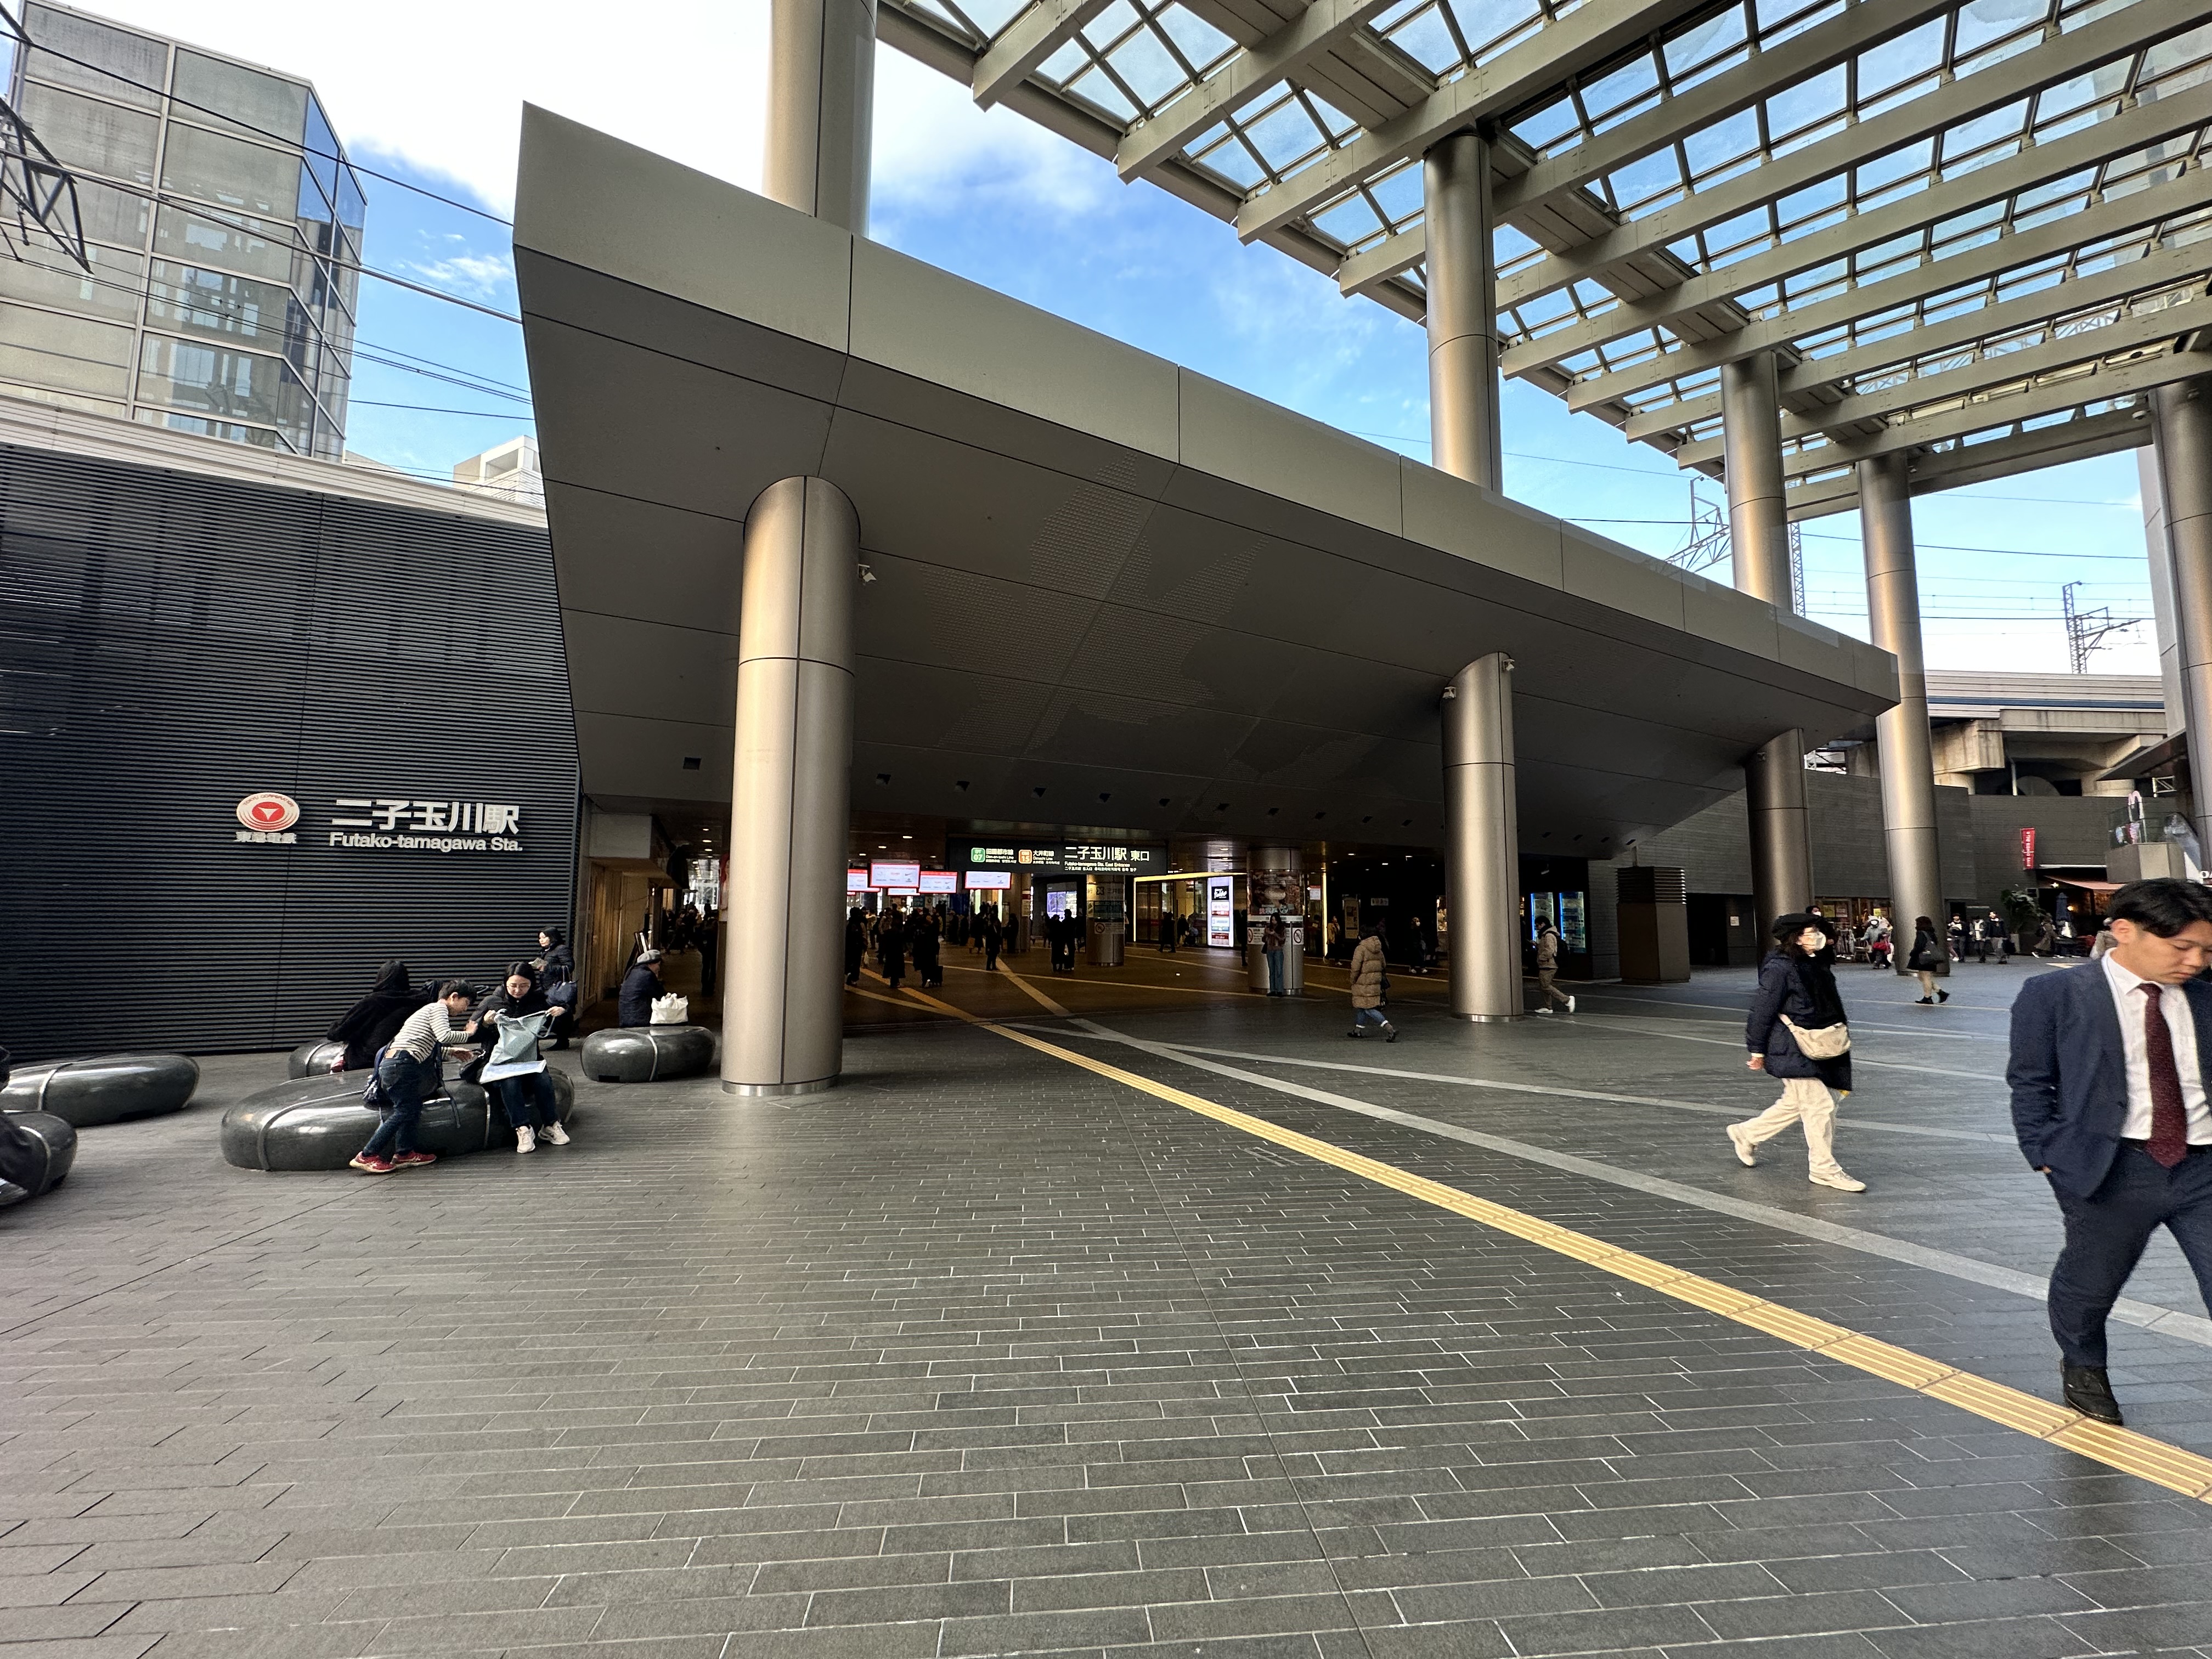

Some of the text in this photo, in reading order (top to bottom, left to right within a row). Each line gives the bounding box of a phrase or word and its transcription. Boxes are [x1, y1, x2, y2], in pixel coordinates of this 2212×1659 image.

[242, 794, 295, 807] TOKYU CORPORATION
[332, 799, 520, 835] 二子玉川駅
[329, 832, 523, 853] Futako-tamagawa Sta.
[1064, 847, 1149, 861] 二子玉川駅 東口
